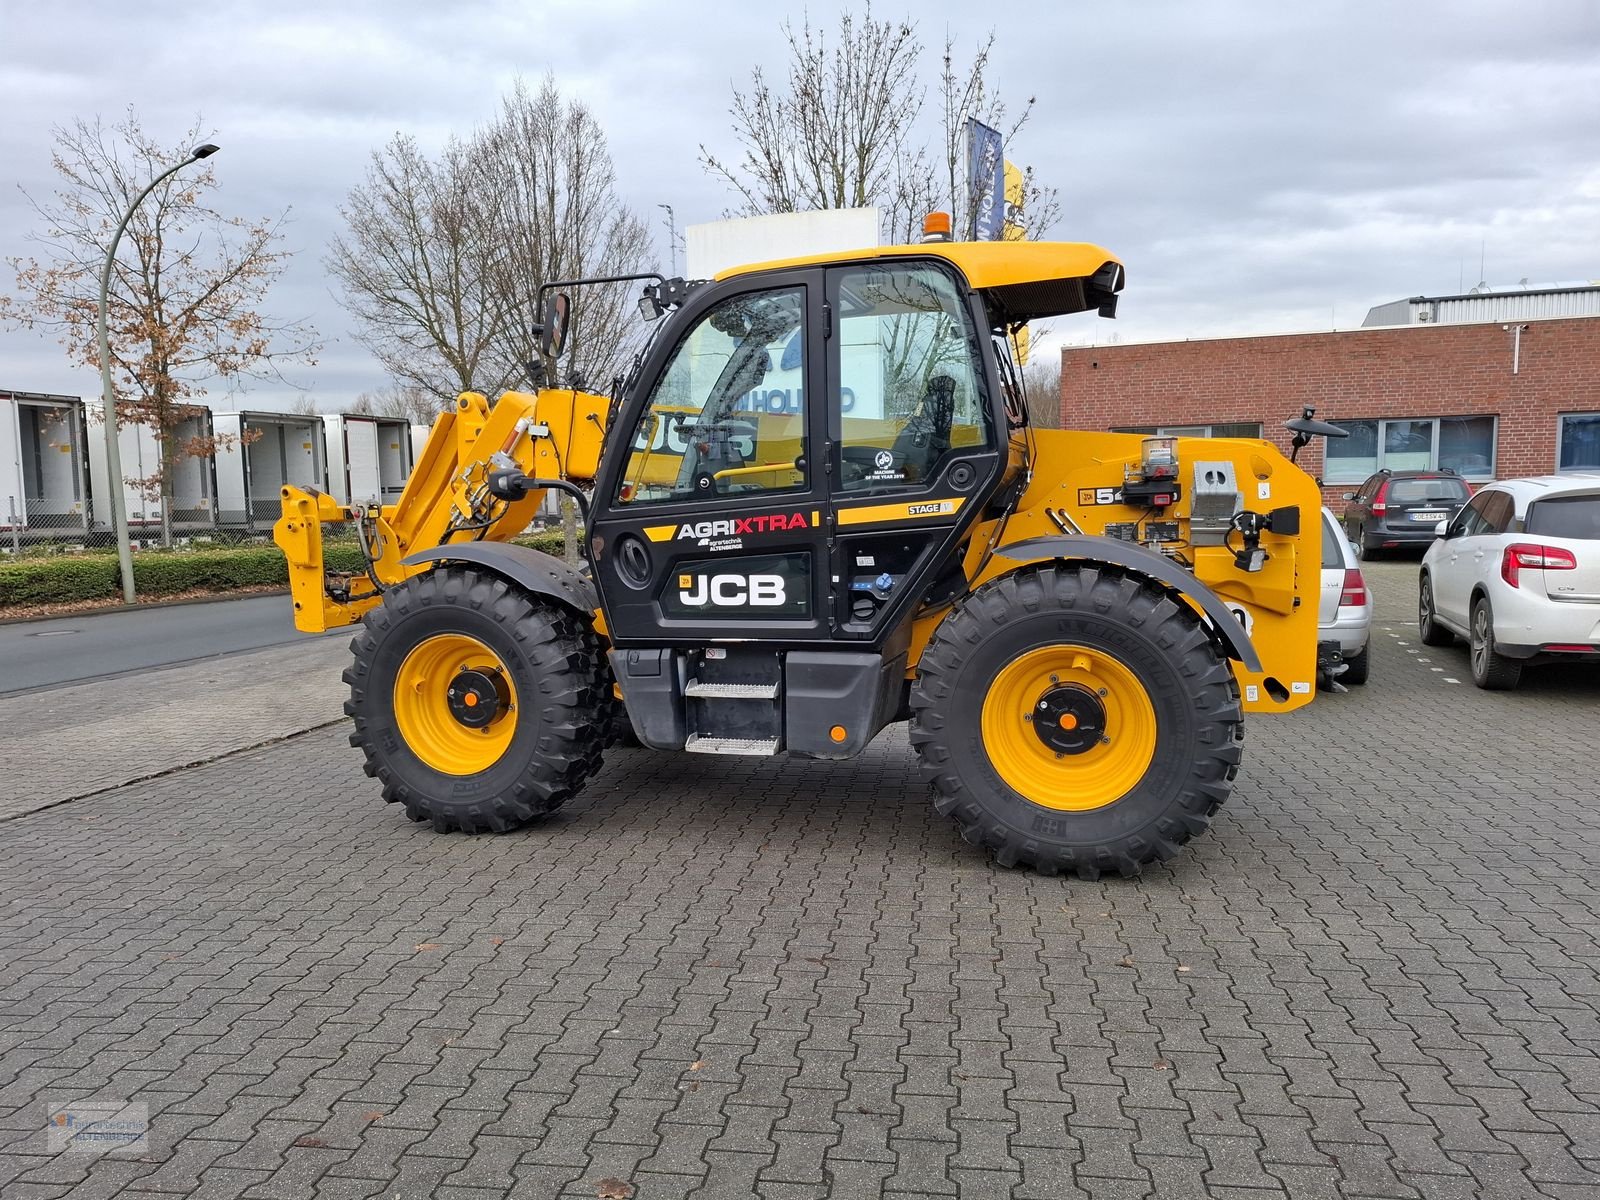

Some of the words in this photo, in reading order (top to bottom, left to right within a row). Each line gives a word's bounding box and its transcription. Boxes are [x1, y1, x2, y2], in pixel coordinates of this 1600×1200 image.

[909, 504, 940, 514] STAGE
[677, 513, 807, 540] AGRIXTRA
[710, 544, 743, 552] ALTENBERGE
[680, 574, 786, 606] JCB
